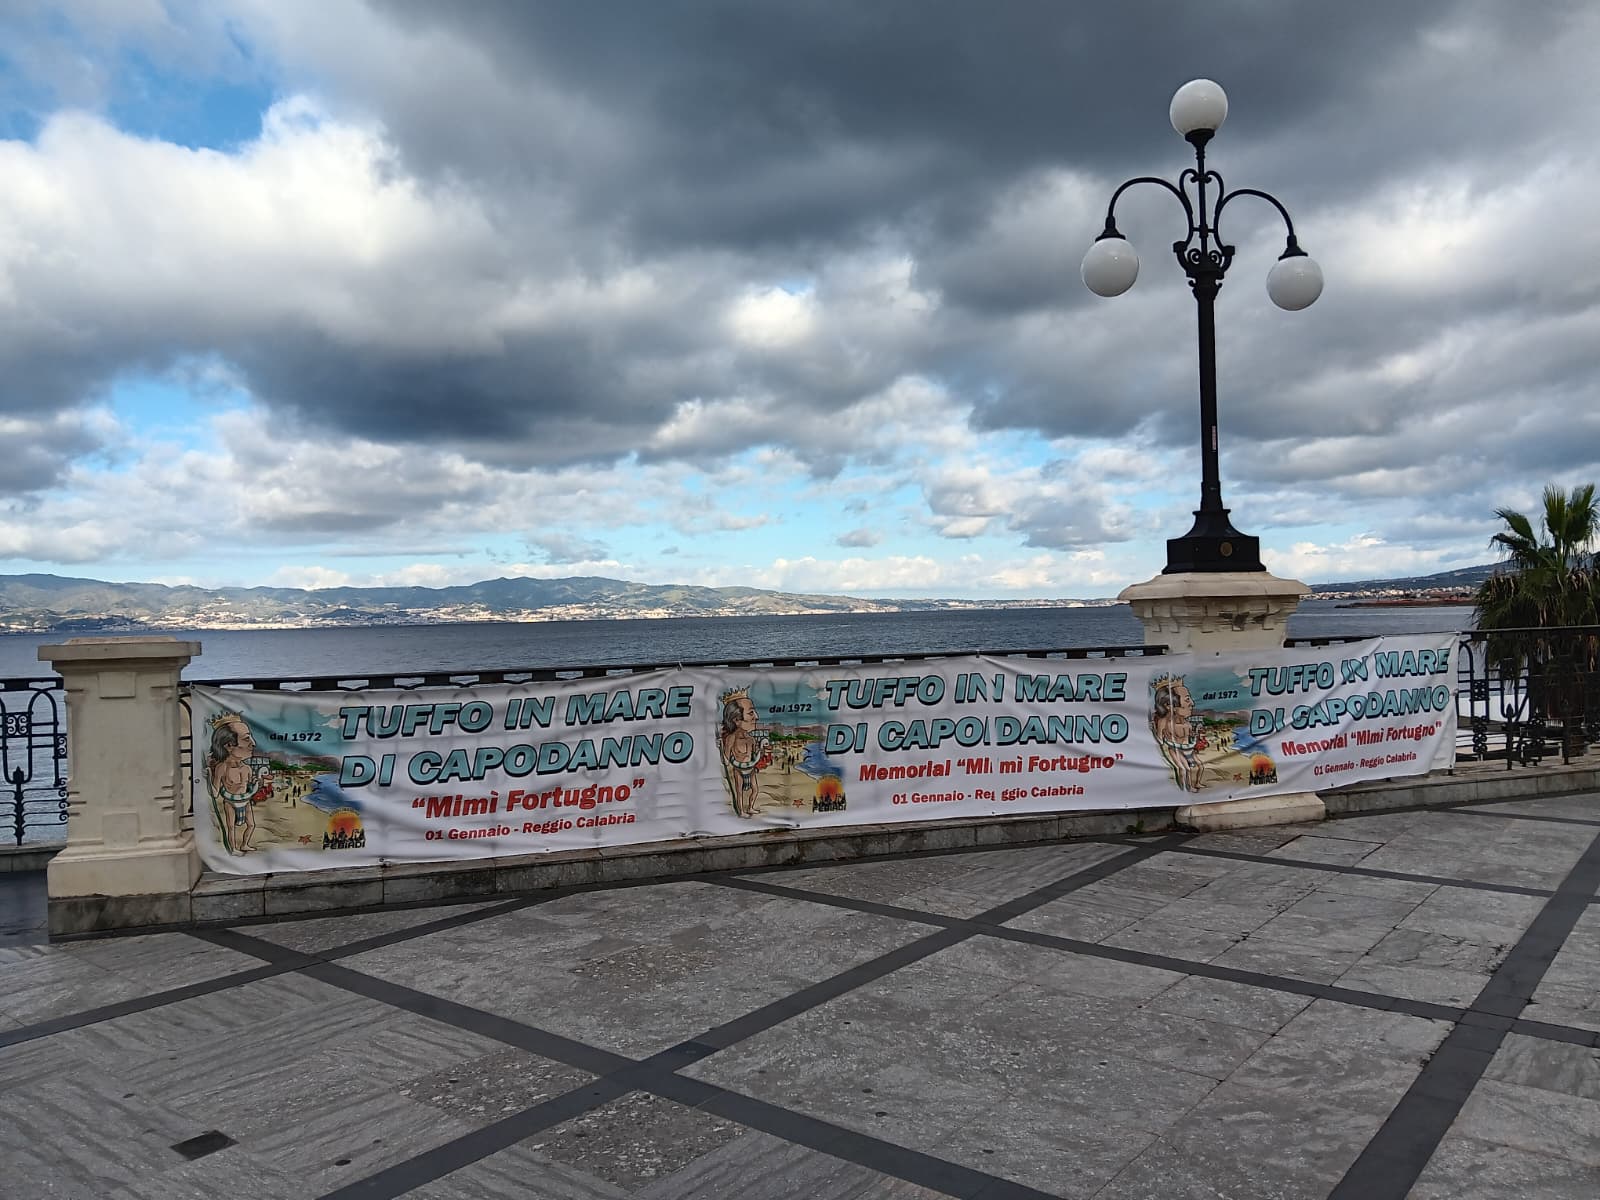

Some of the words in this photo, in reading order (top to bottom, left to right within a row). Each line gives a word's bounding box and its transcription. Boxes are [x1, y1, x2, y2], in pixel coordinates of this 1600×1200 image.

[1249, 662, 1335, 697] TUFFO
[1341, 656, 1369, 684] IN
[1374, 648, 1450, 679] MARE
[825, 675, 946, 710] TUFFO
[1015, 673, 1128, 702] MARE
[1203, 692, 1216, 700] dal
[1218, 690, 1238, 699] 1972
[340, 701, 493, 740] TUFFO
[505, 697, 558, 730] IN
[565, 686, 694, 727] MARE
[769, 704, 786, 713] dal
[788, 703, 812, 713] 1972
[1249, 707, 1285, 736] DI
[1291, 684, 1450, 731] CAPODANNO
[269, 732, 288, 741] dal
[291, 732, 322, 742] 1972
[825, 723, 868, 754] DI
[1281, 733, 1347, 756] Memorial
[339, 754, 397, 787] DI
[408, 731, 694, 785] CAPODANNO
[859, 759, 951, 781] Memorial
[1314, 765, 1323, 776] 01
[1325, 760, 1354, 775] Gennaio
[1360, 757, 1384, 769] Reggio
[1386, 752, 1417, 765] Calabria
[892, 793, 908, 805] 01
[911, 790, 964, 804] Gennaio
[1031, 784, 1084, 798] Calabria
[425, 829, 443, 841] 01
[449, 824, 510, 840] Gennaio
[522, 816, 572, 834] Reggio
[576, 813, 636, 828] Calabria
